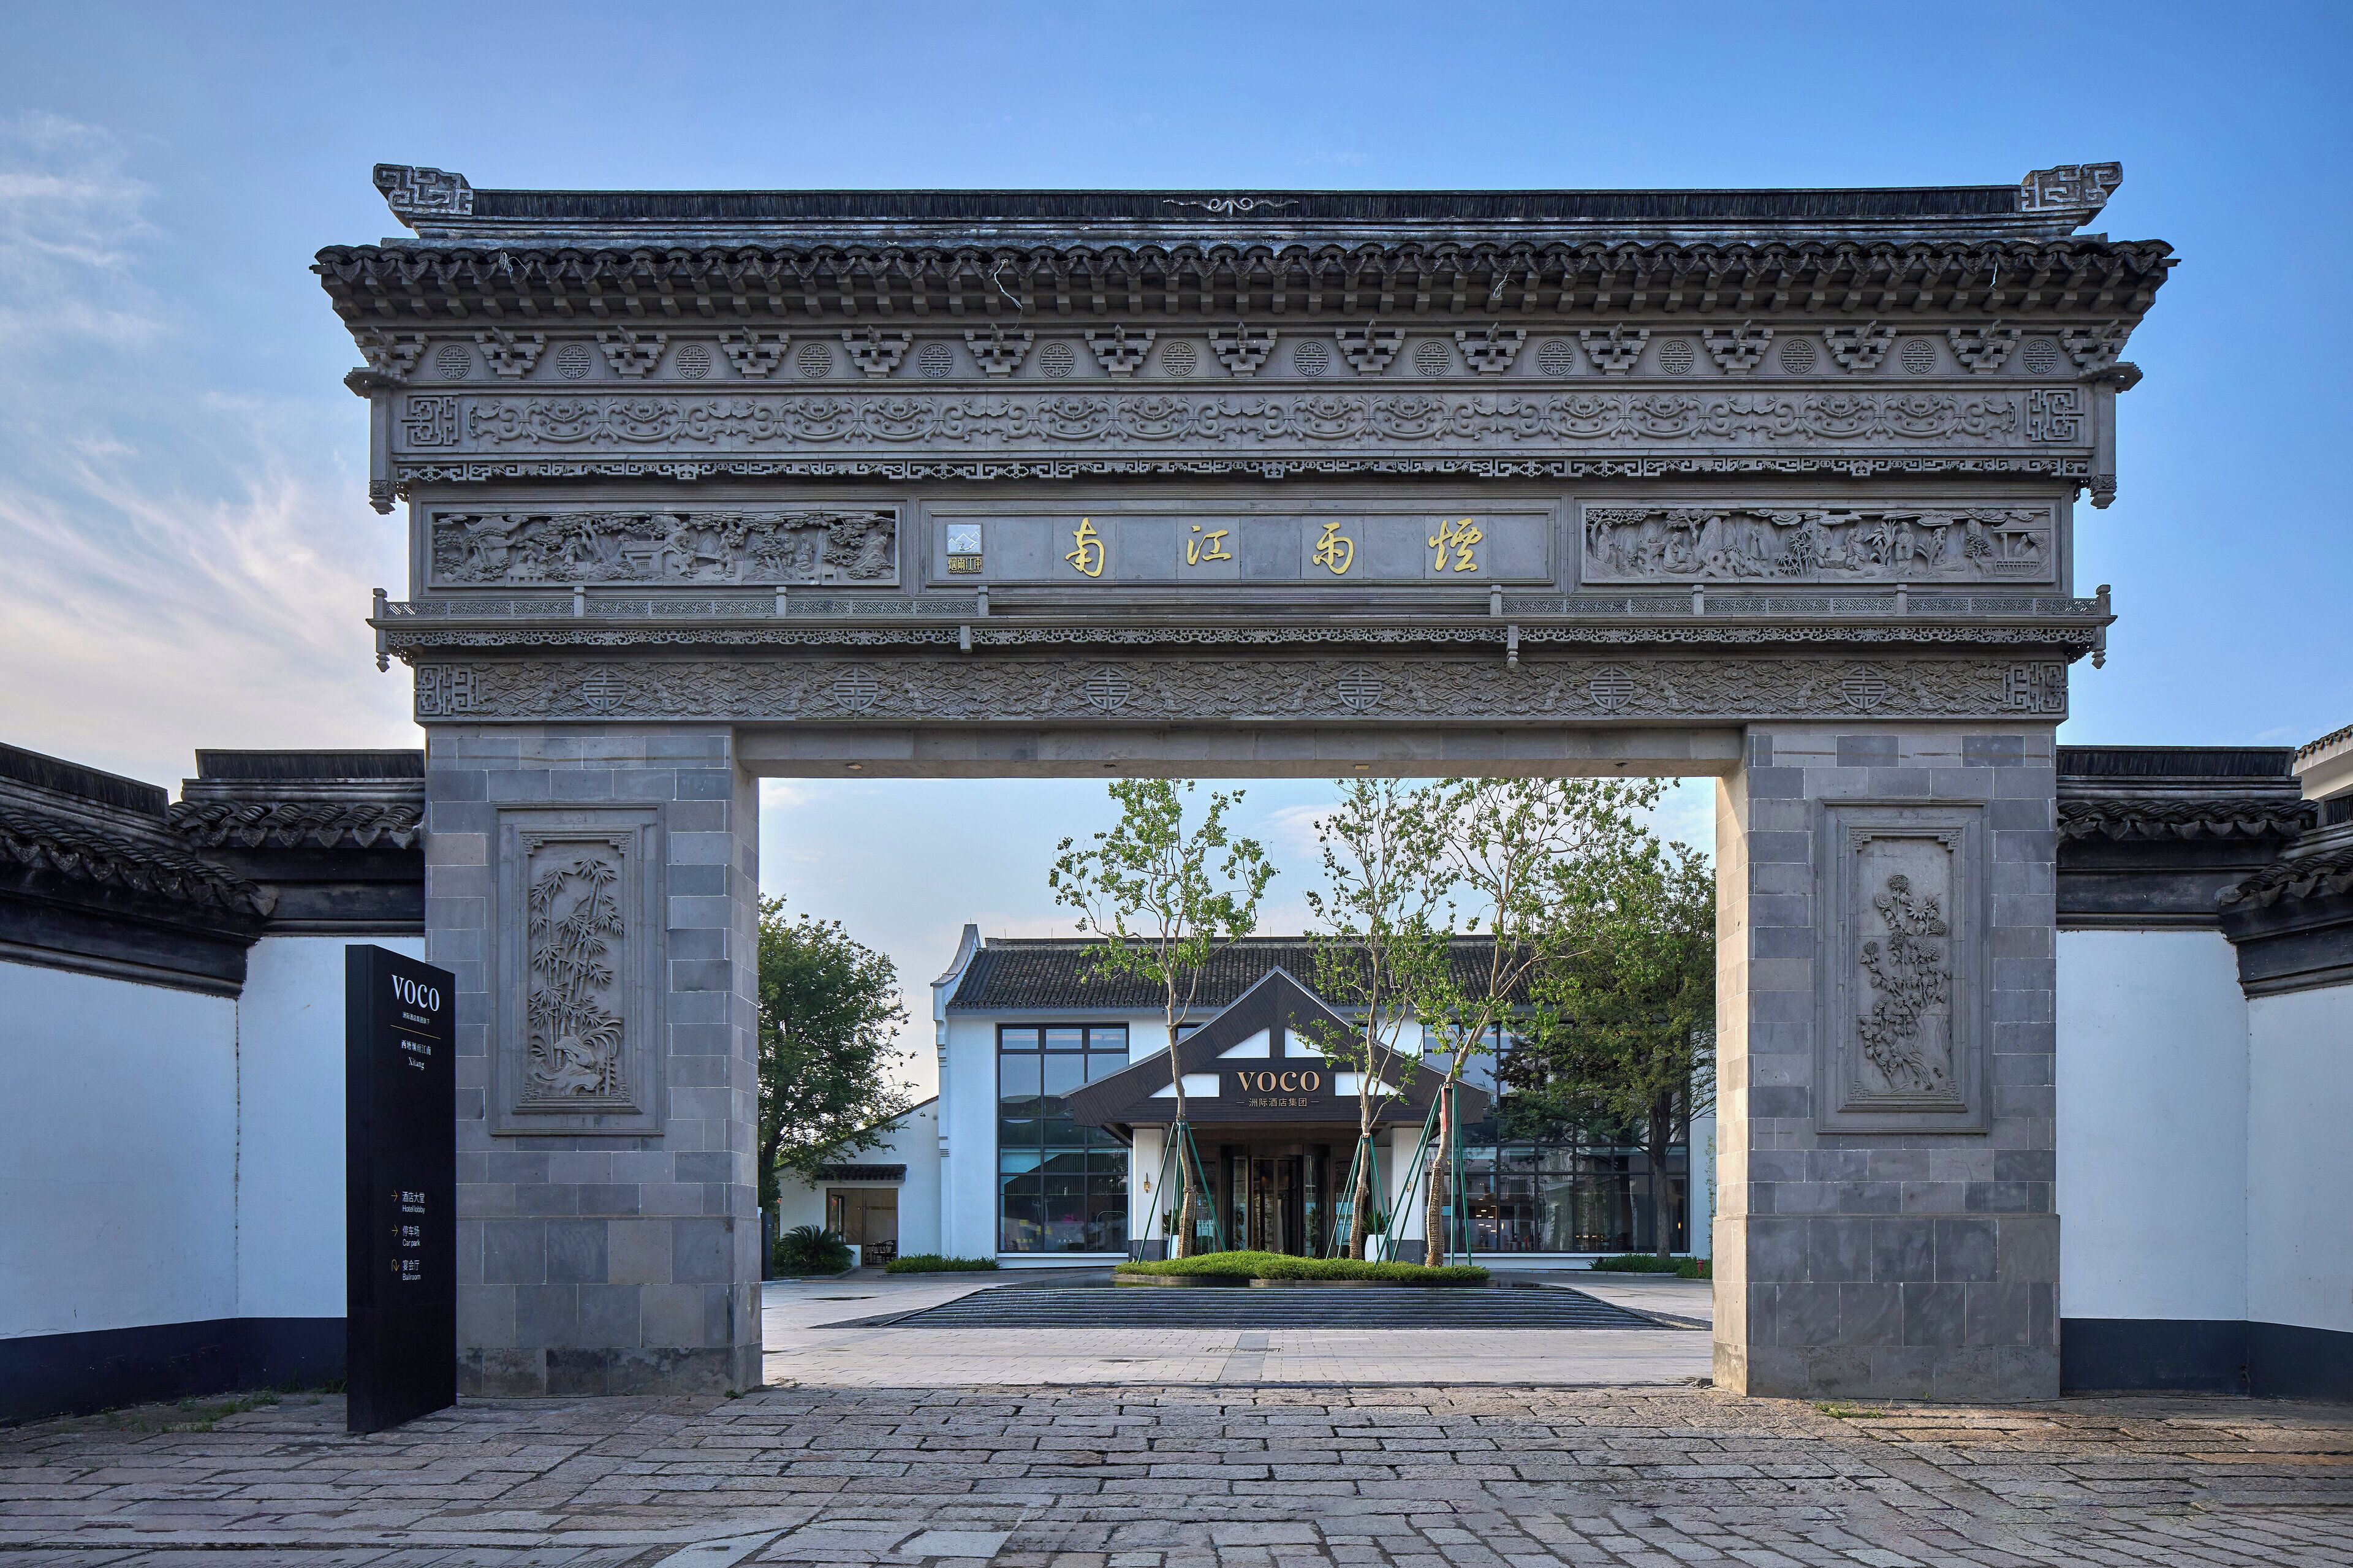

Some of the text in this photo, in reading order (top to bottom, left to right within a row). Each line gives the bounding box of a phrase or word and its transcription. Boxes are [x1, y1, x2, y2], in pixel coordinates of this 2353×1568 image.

[392, 974, 440, 1012] VOCO
[1236, 1071, 1320, 1092] VOCO
[1249, 1098, 1307, 1107] 洲际酒店集团
[403, 1192, 425, 1203] 酒店大堂
[414, 1205, 425, 1214] lobby
[403, 1226, 420, 1237] 停车场
[403, 1260, 420, 1271] 宴会厅
